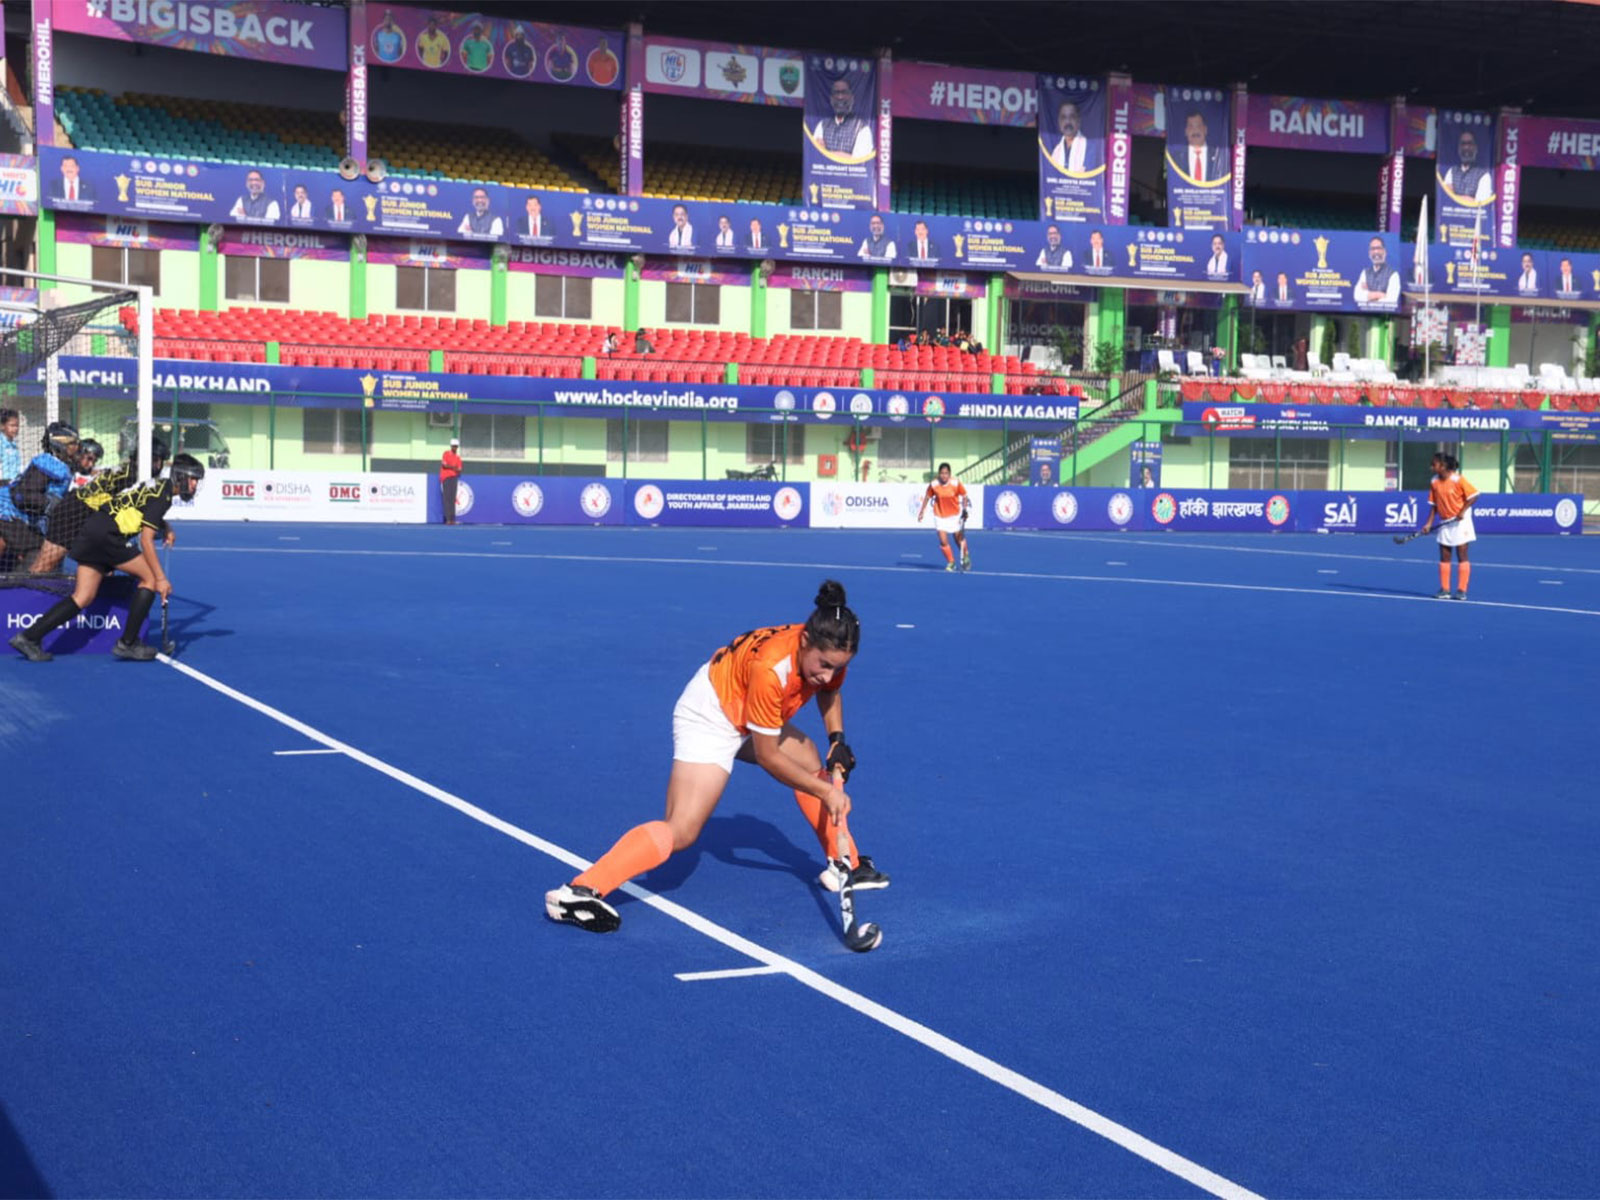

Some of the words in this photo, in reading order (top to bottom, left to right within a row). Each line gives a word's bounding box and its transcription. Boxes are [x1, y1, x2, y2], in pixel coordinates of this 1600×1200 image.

[86, 0, 314, 50] #BIGISBACK
[37, 18, 51, 105] #HEROHIL
[353, 44, 366, 142] #BIGISBACK
[630, 83, 642, 159] #HEROHIL
[1269, 109, 1365, 138] RANCHI
[881, 98, 892, 186] #BIGISBACK
[1111, 102, 1129, 218] #HEROHIL
[1233, 128, 1246, 210] #BIGISBACK
[1501, 128, 1518, 247] #BIGISBACK
[241, 231, 325, 249] #HEROHIL
[510, 250, 618, 270] #BIGISBACK
[792, 266, 844, 281] RANCHI
[383, 379, 402, 389] SUB
[404, 381, 439, 391] JUNIOR
[383, 389, 420, 399] WOMEN
[422, 392, 468, 400] NATIONAL
[554, 389, 738, 413] www.hockeyindia.org
[959, 404, 1077, 420] #INDIAKAGAME
[222, 483, 255, 497] OMC
[329, 486, 361, 499] OMC
[845, 496, 890, 508] ODISHA
[77, 614, 121, 630] INDIA
